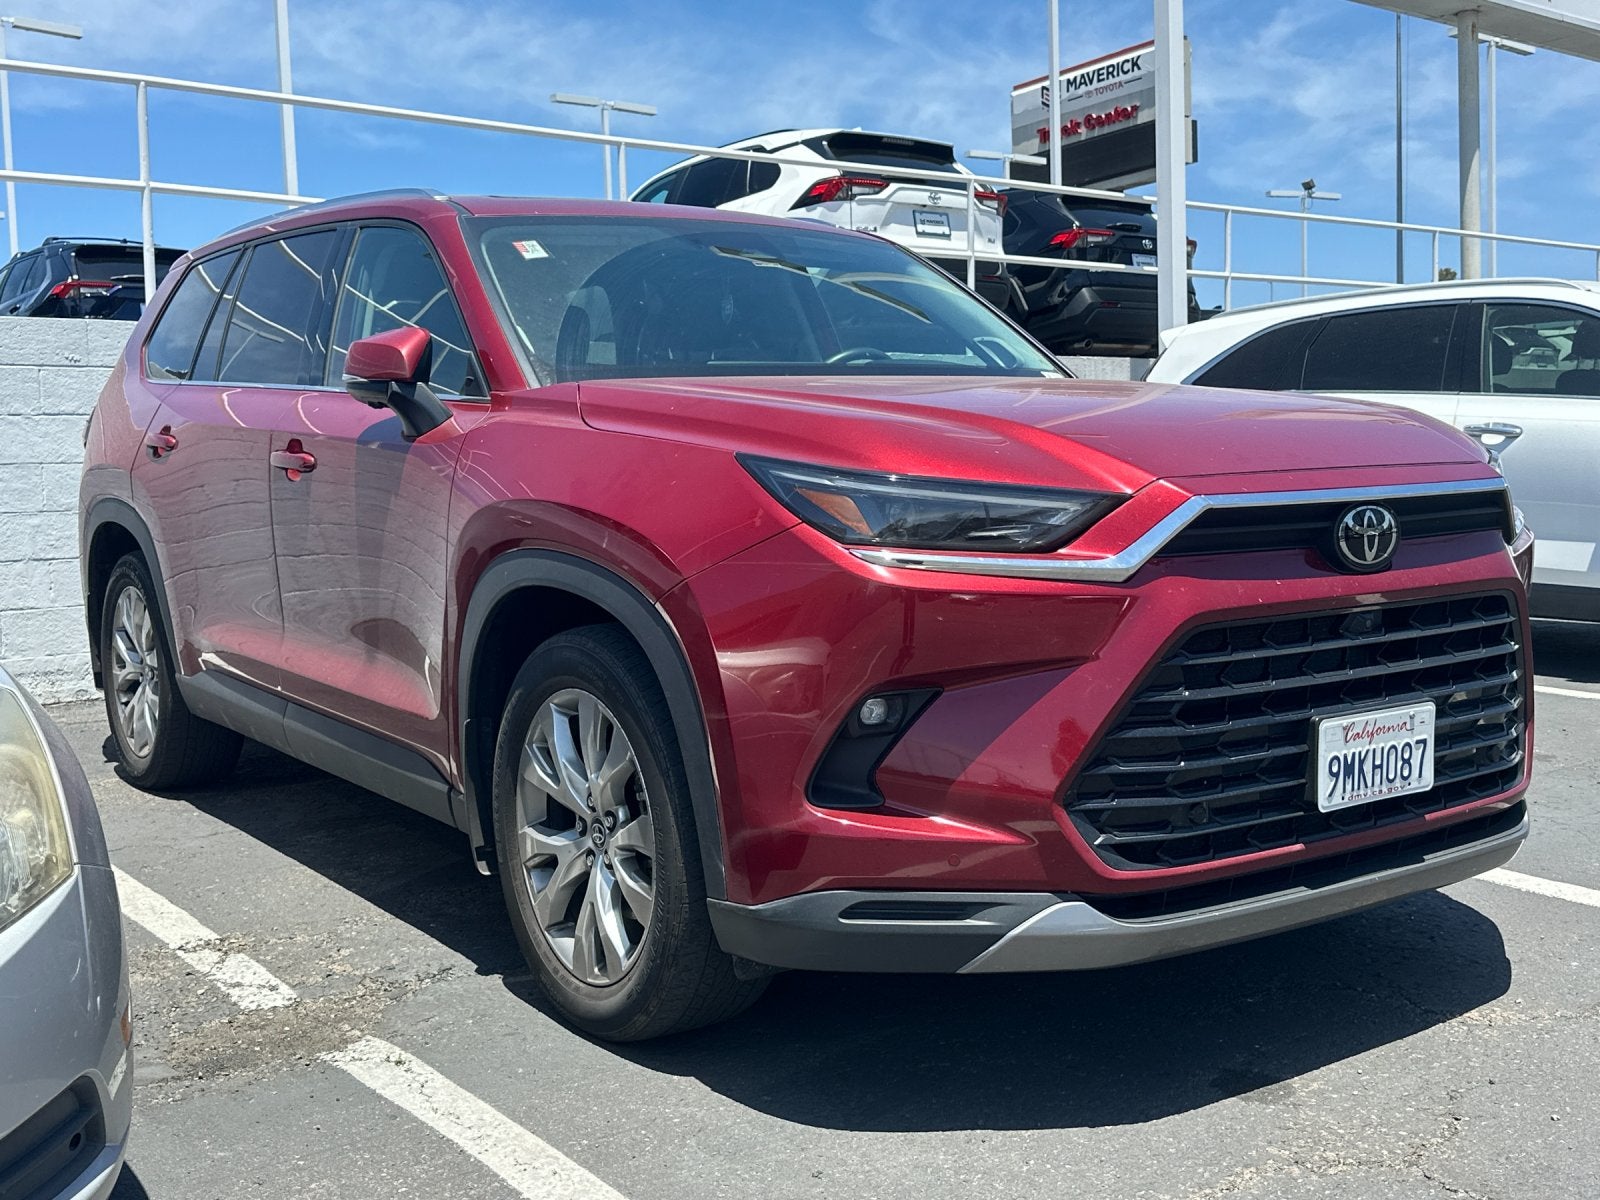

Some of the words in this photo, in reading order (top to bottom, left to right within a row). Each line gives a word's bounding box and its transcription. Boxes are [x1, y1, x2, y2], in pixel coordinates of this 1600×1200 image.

[1066, 55, 1142, 93] MAVERICK
[1094, 80, 1124, 97] TOYOTA
[1083, 104, 1140, 130] Center
[1343, 718, 1415, 745] California
[1327, 737, 1428, 798] 9MKH087
[1347, 784, 1406, 802] dmv.ca.gov
